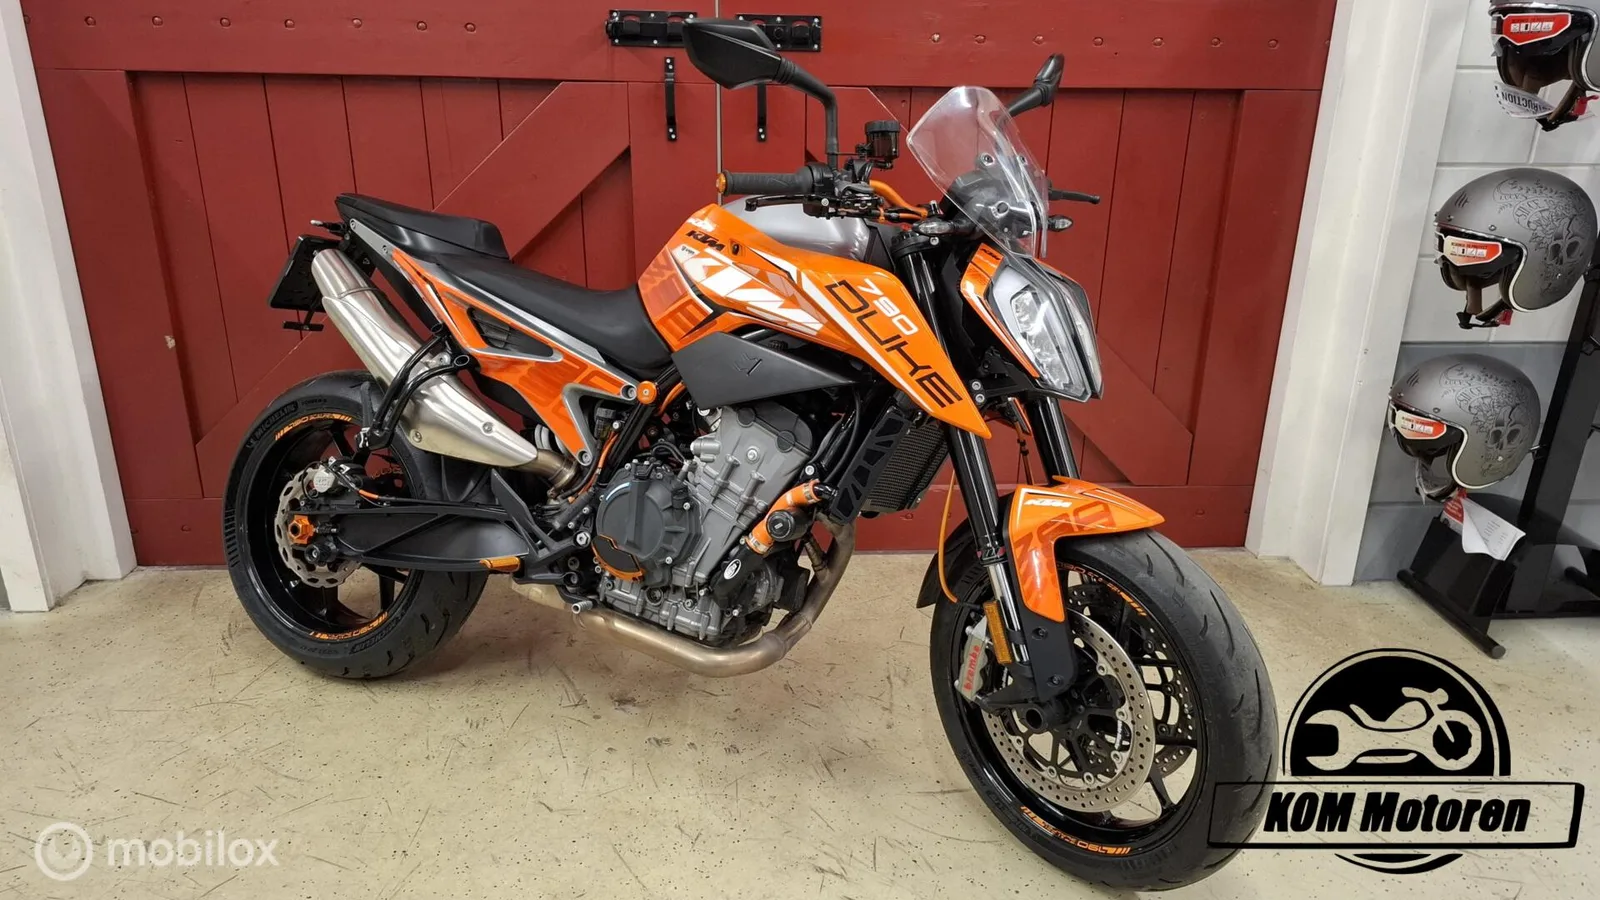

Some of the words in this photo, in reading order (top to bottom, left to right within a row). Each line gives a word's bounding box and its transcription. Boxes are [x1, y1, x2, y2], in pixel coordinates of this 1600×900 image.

[686, 230, 725, 251] KTM
[858, 278, 919, 336] 790
[824, 279, 963, 408] DUKE
[962, 643, 981, 691] brembo
